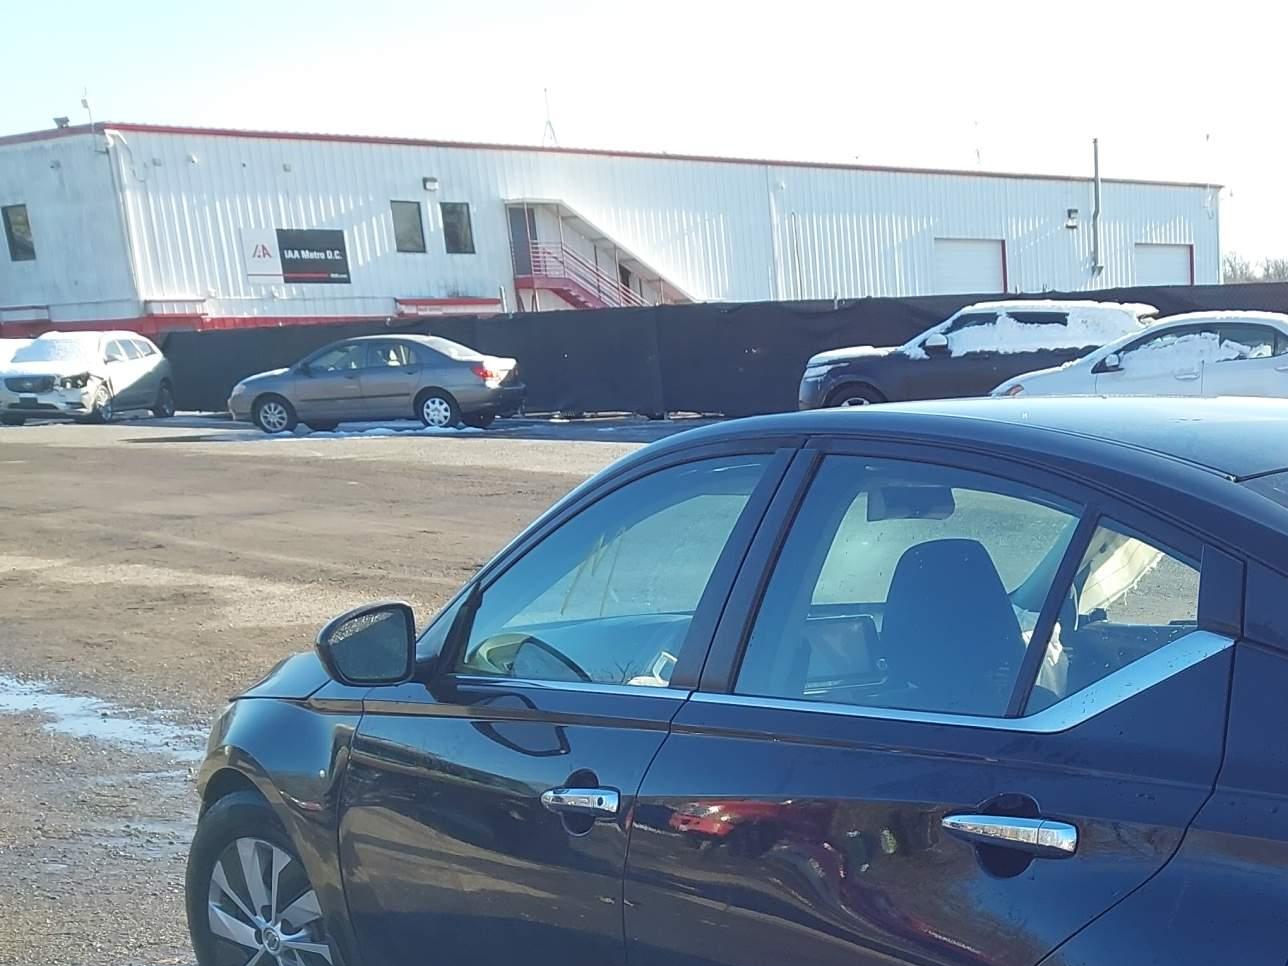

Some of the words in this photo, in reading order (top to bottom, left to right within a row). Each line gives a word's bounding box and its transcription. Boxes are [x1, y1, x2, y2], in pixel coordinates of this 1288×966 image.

[284, 249, 300, 260] IAA
[301, 250, 325, 260] Metro
[326, 250, 342, 260] D.C.
